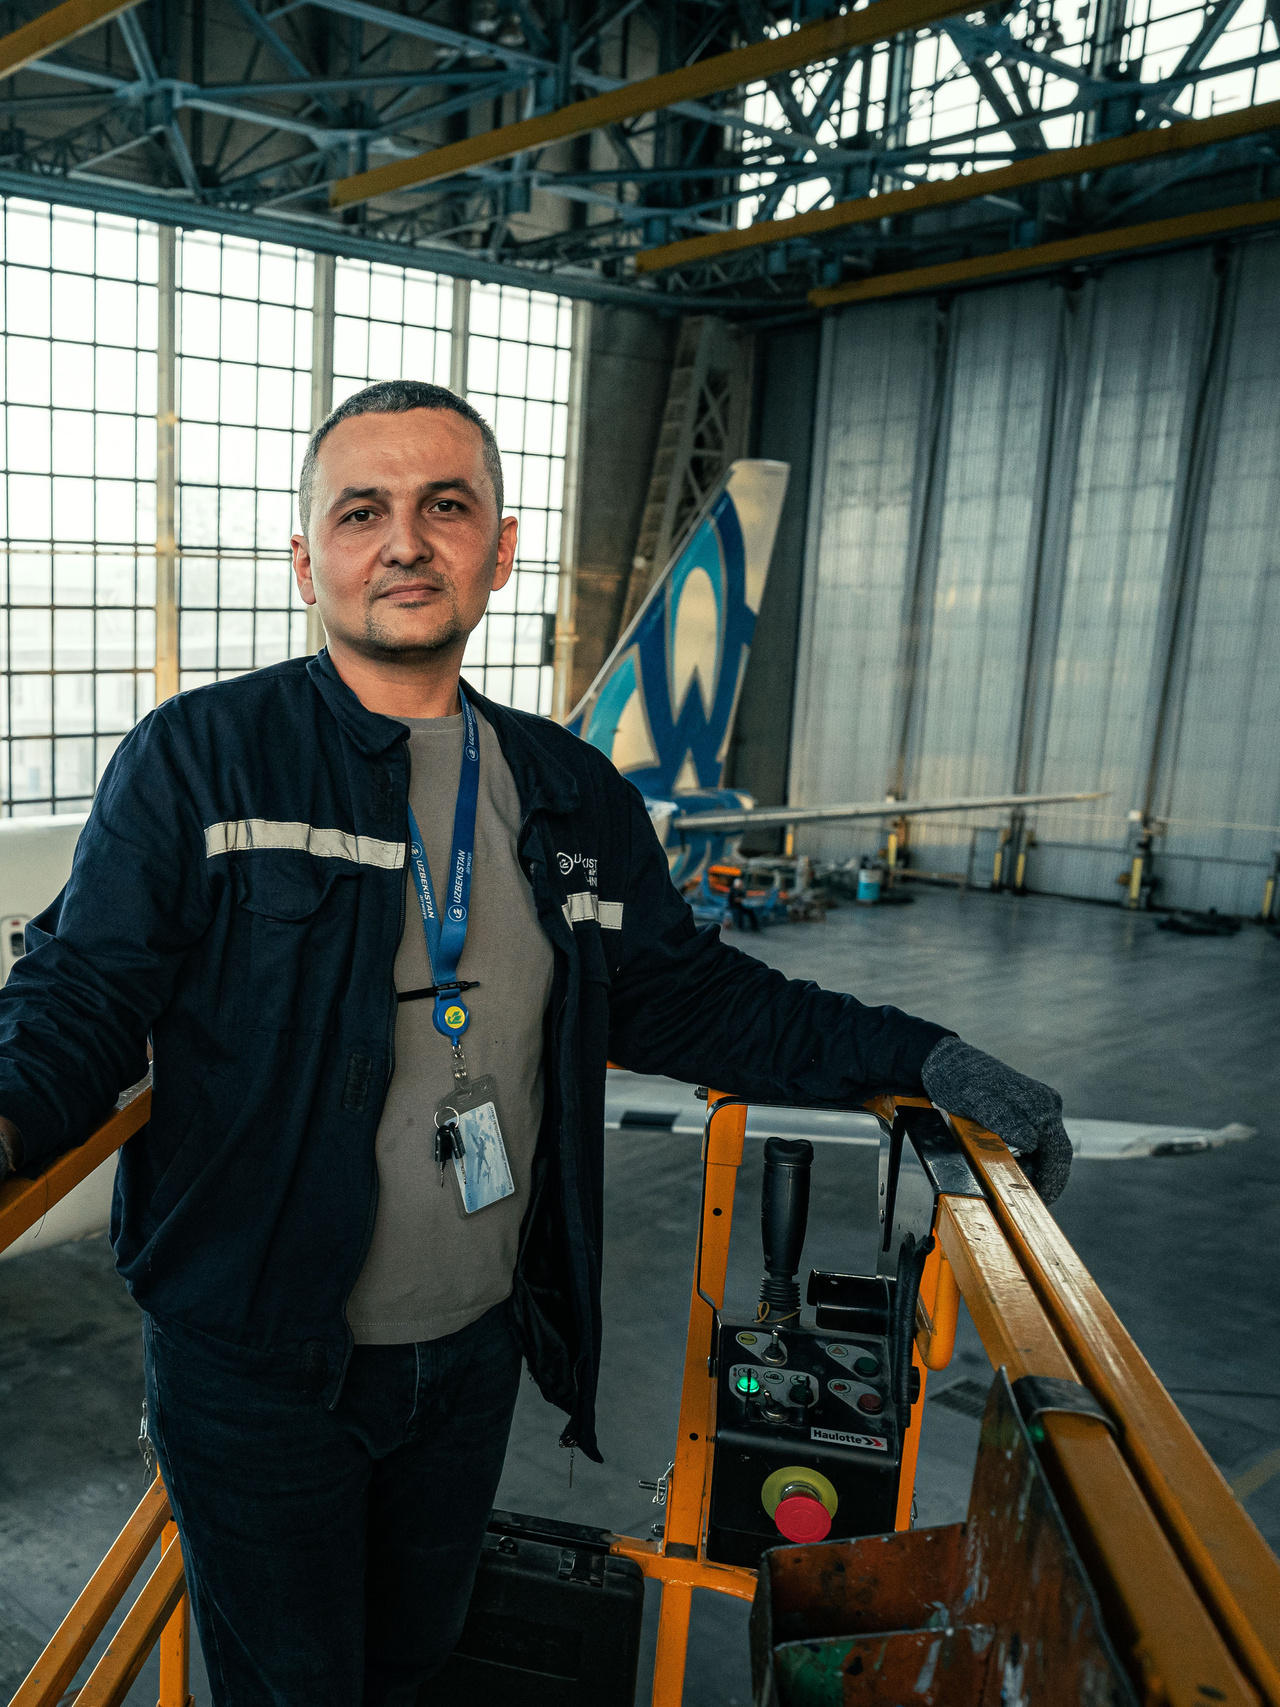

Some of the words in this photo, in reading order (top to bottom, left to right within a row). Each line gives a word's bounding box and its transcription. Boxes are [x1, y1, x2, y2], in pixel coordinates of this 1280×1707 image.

[416, 859, 435, 919] UZBEKISTAN
[453, 849, 466, 904] UZBEKISTAN
[813, 1429, 862, 1444] Haulotte
